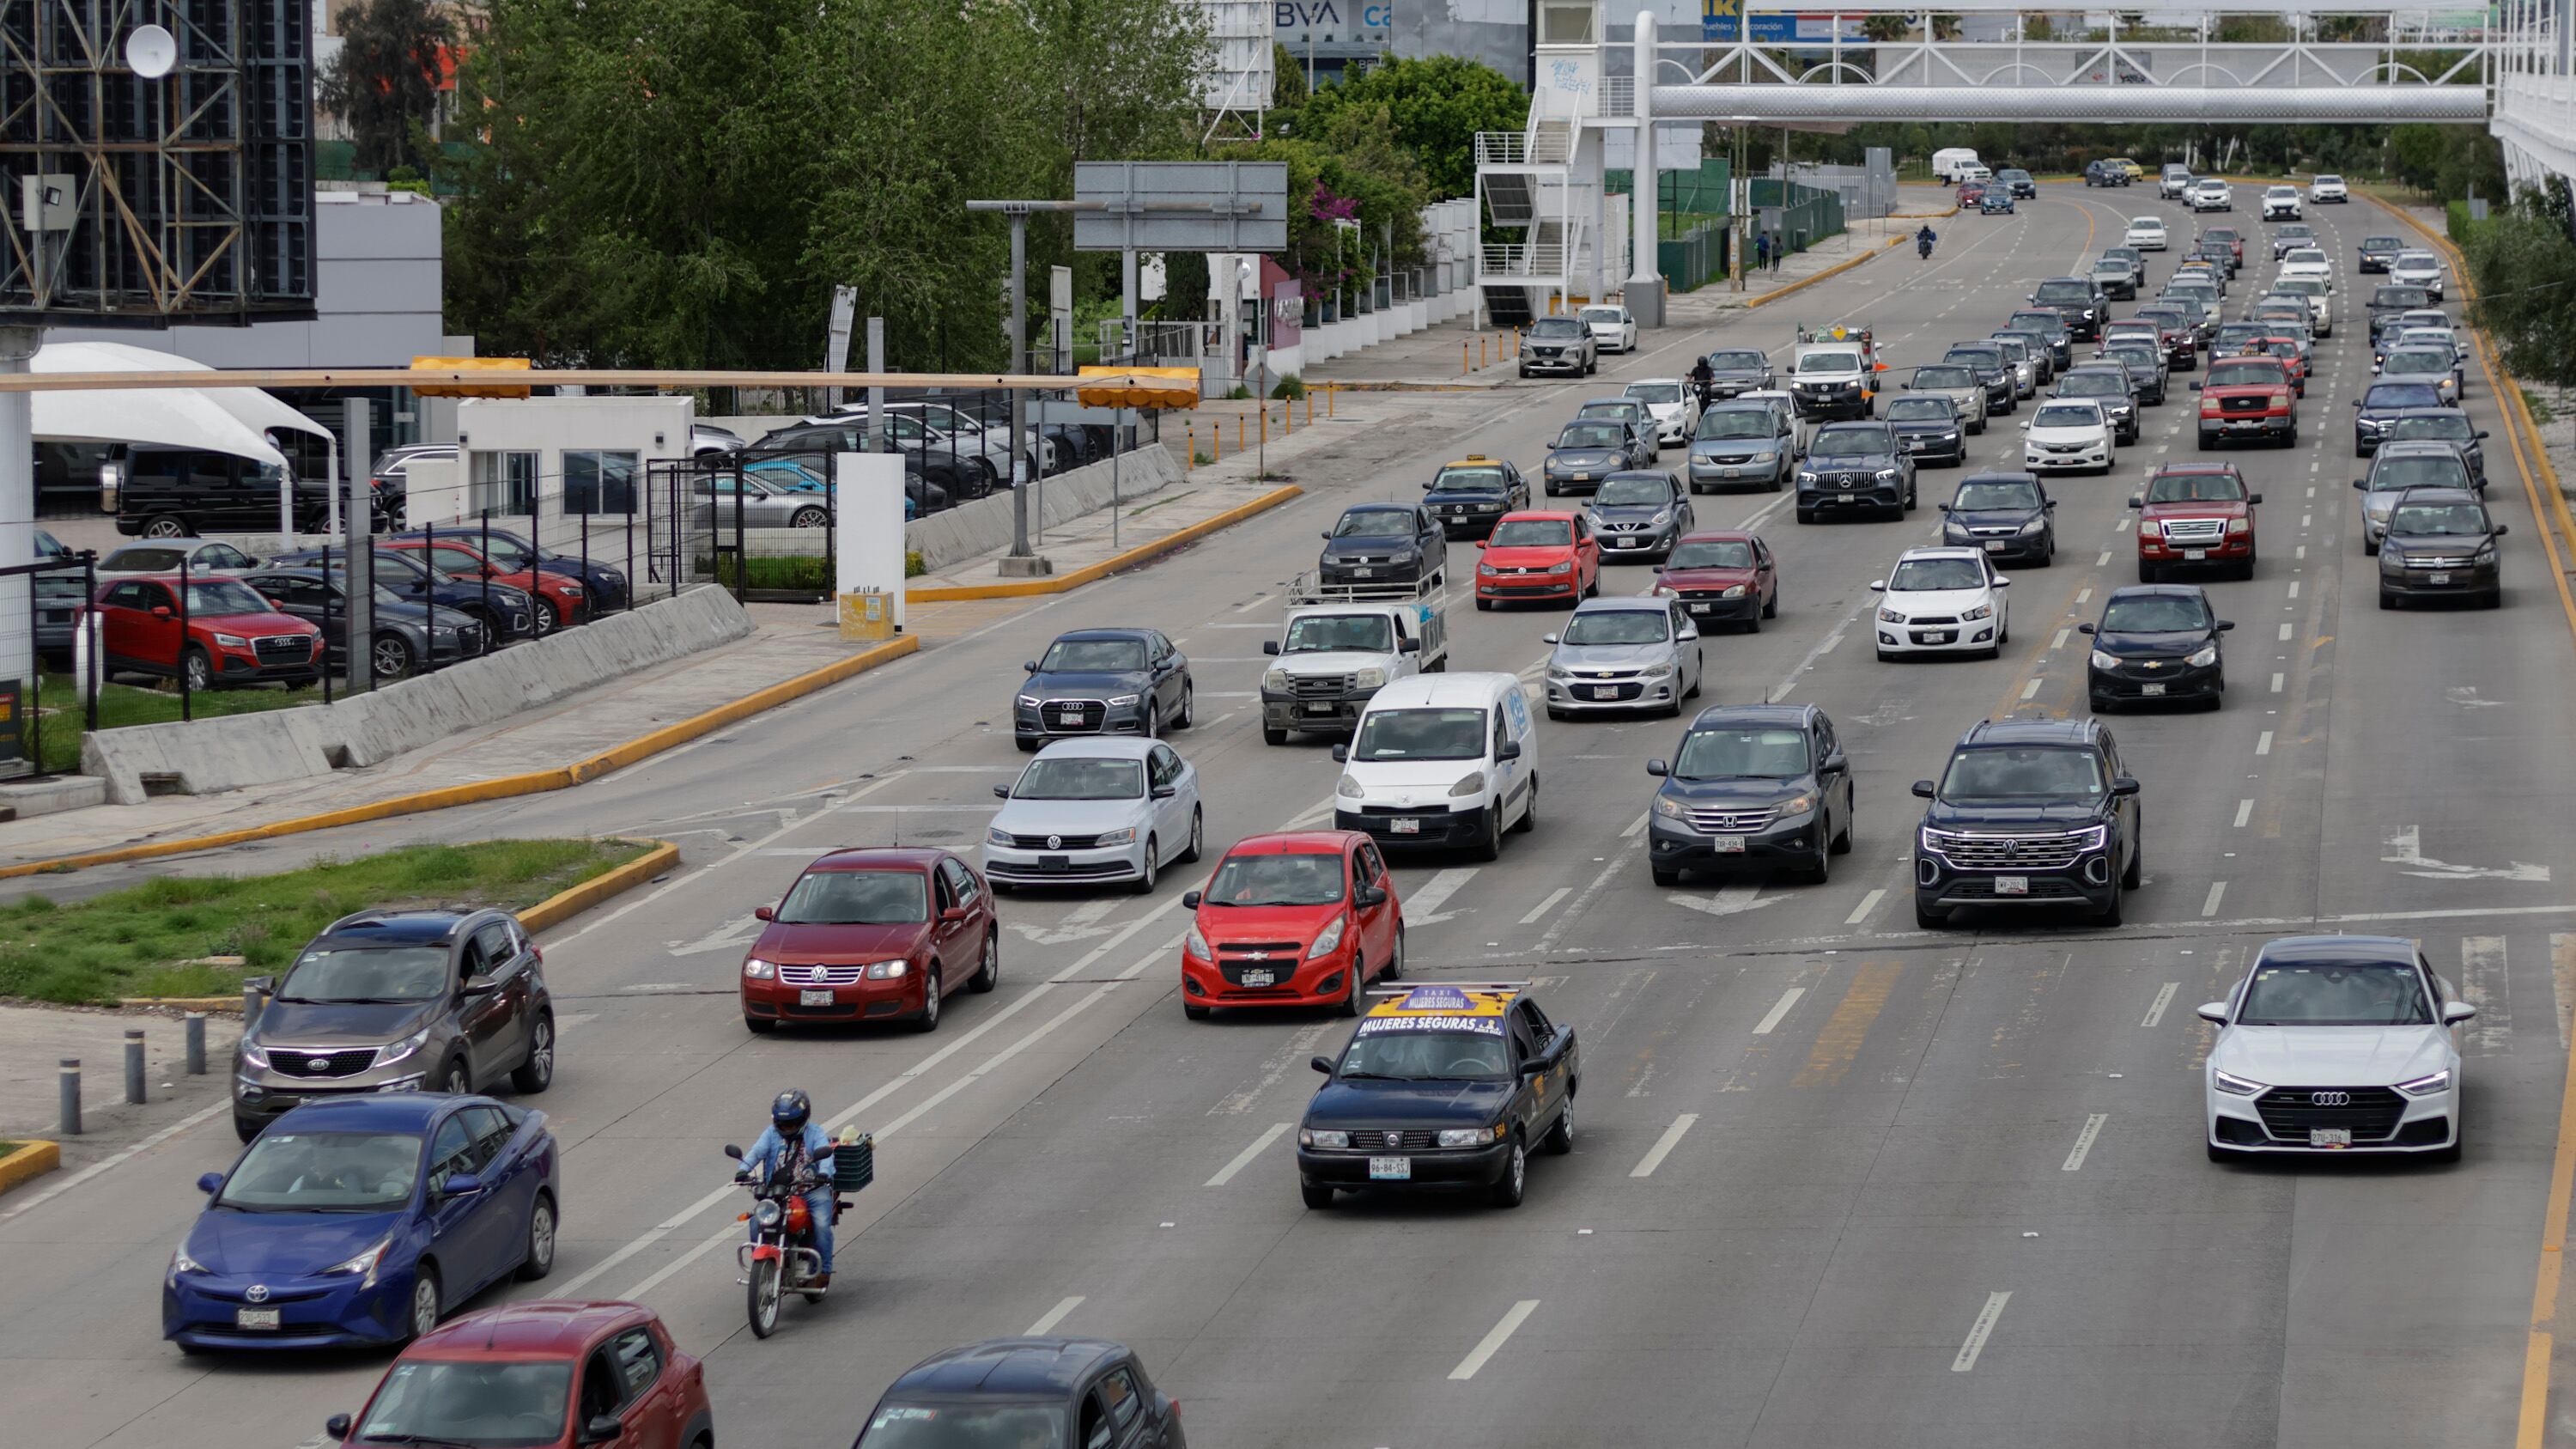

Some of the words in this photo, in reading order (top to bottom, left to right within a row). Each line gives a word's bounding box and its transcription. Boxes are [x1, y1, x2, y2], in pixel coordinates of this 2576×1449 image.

[1408, 997, 1435, 1008] MUJERES
[1436, 996, 1464, 1008] SEGURAS
[1359, 1017, 1415, 1032] MUJERES
[1416, 1016, 1476, 1032] SEGURAS
